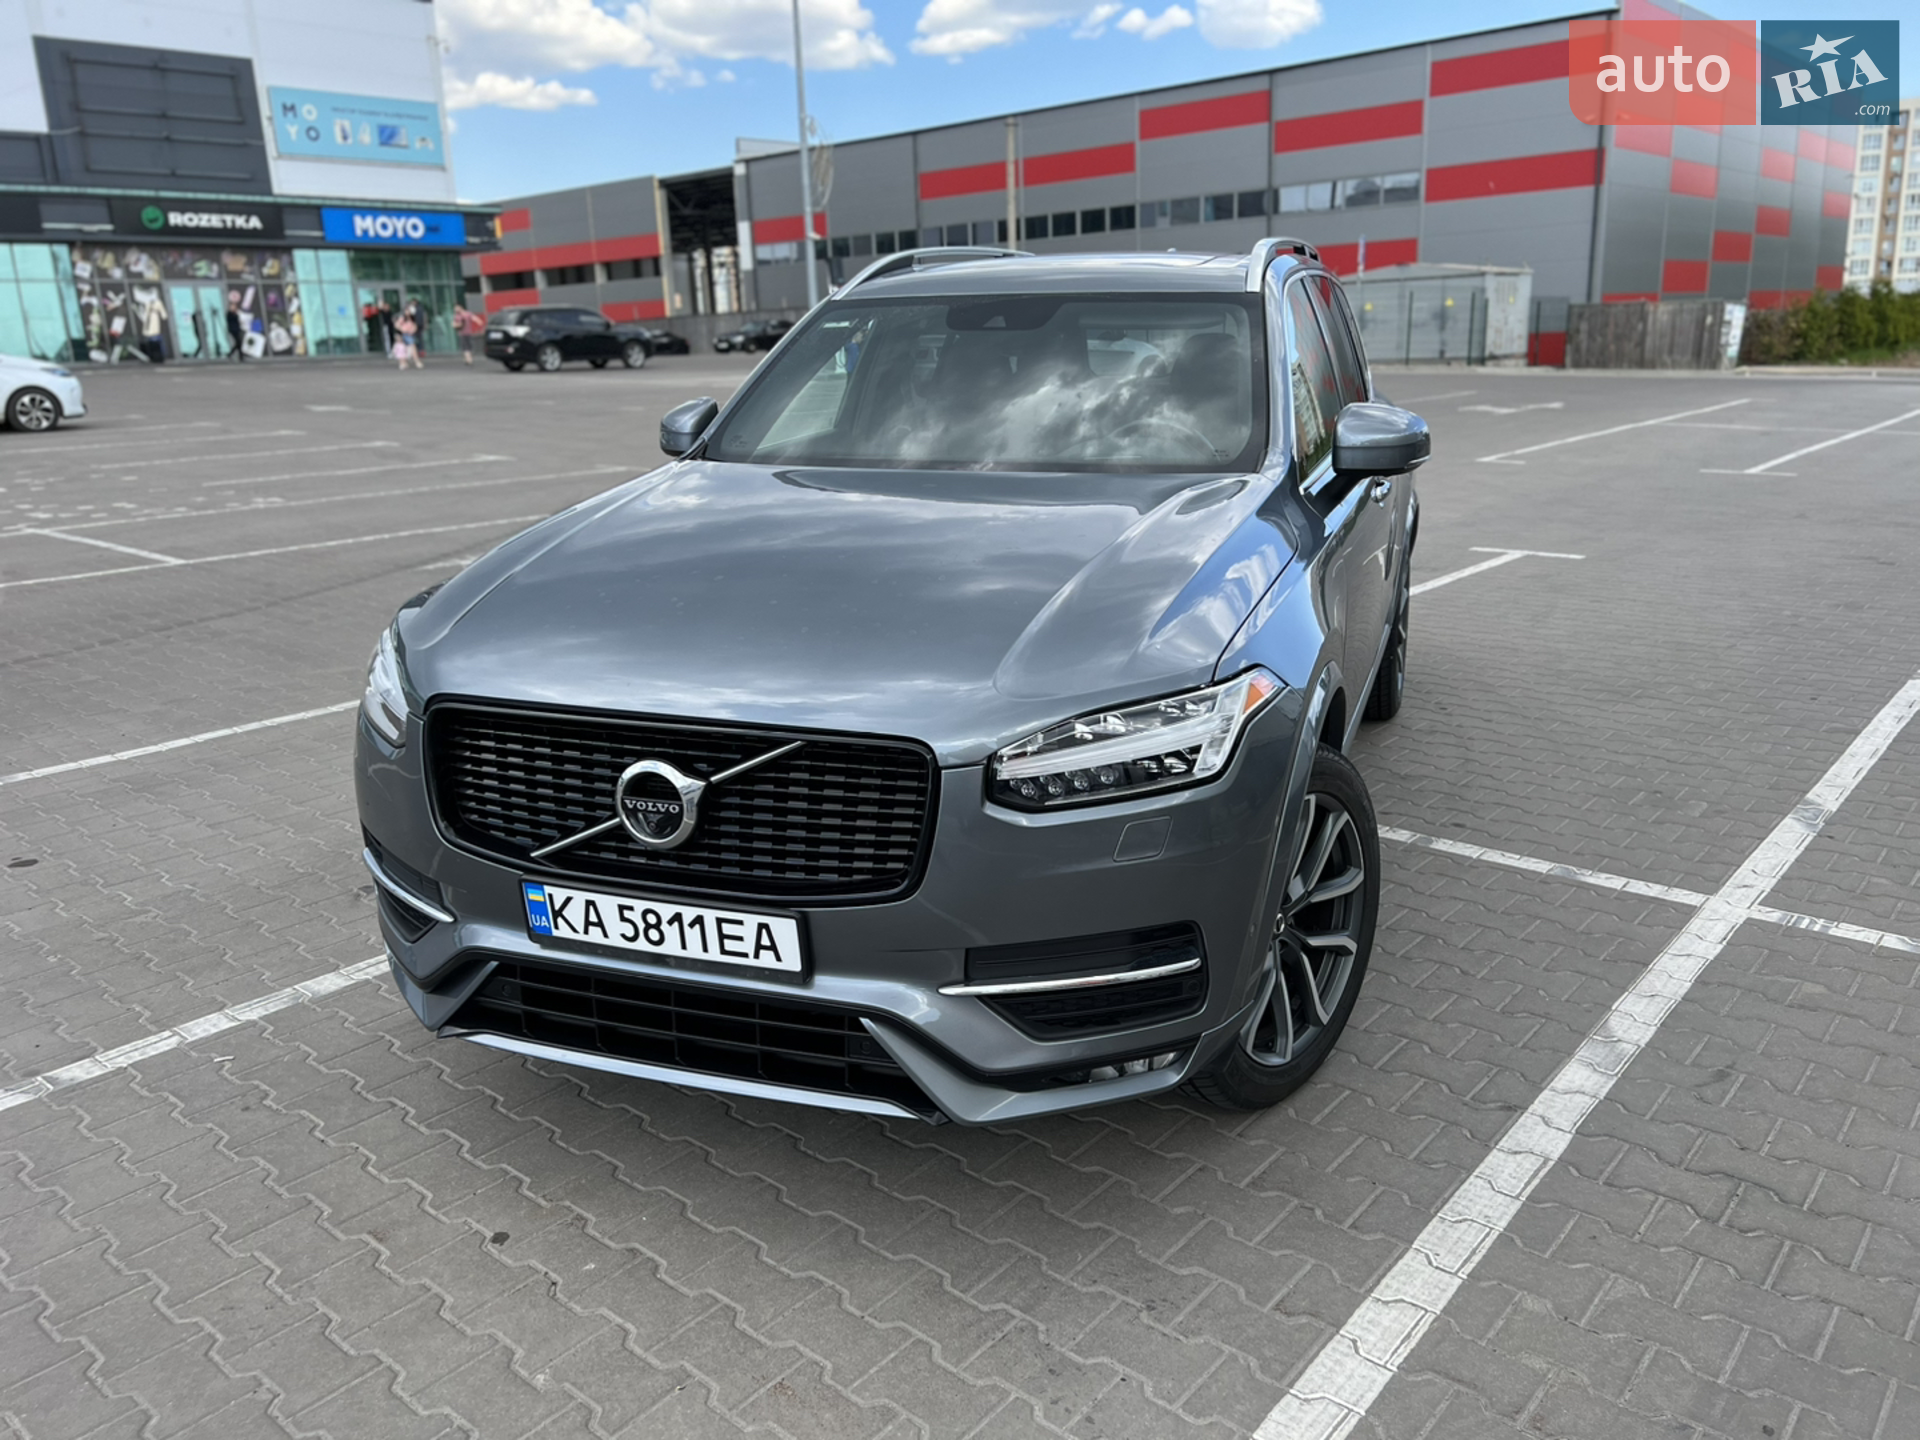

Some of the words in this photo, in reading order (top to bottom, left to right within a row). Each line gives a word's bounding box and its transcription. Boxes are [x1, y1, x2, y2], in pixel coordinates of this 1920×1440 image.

[167, 211, 264, 230] ROZETKA
[353, 214, 426, 239] MOYO
[624, 800, 680, 813] VOLVO
[532, 914, 550, 928] UA
[548, 893, 610, 939] KA
